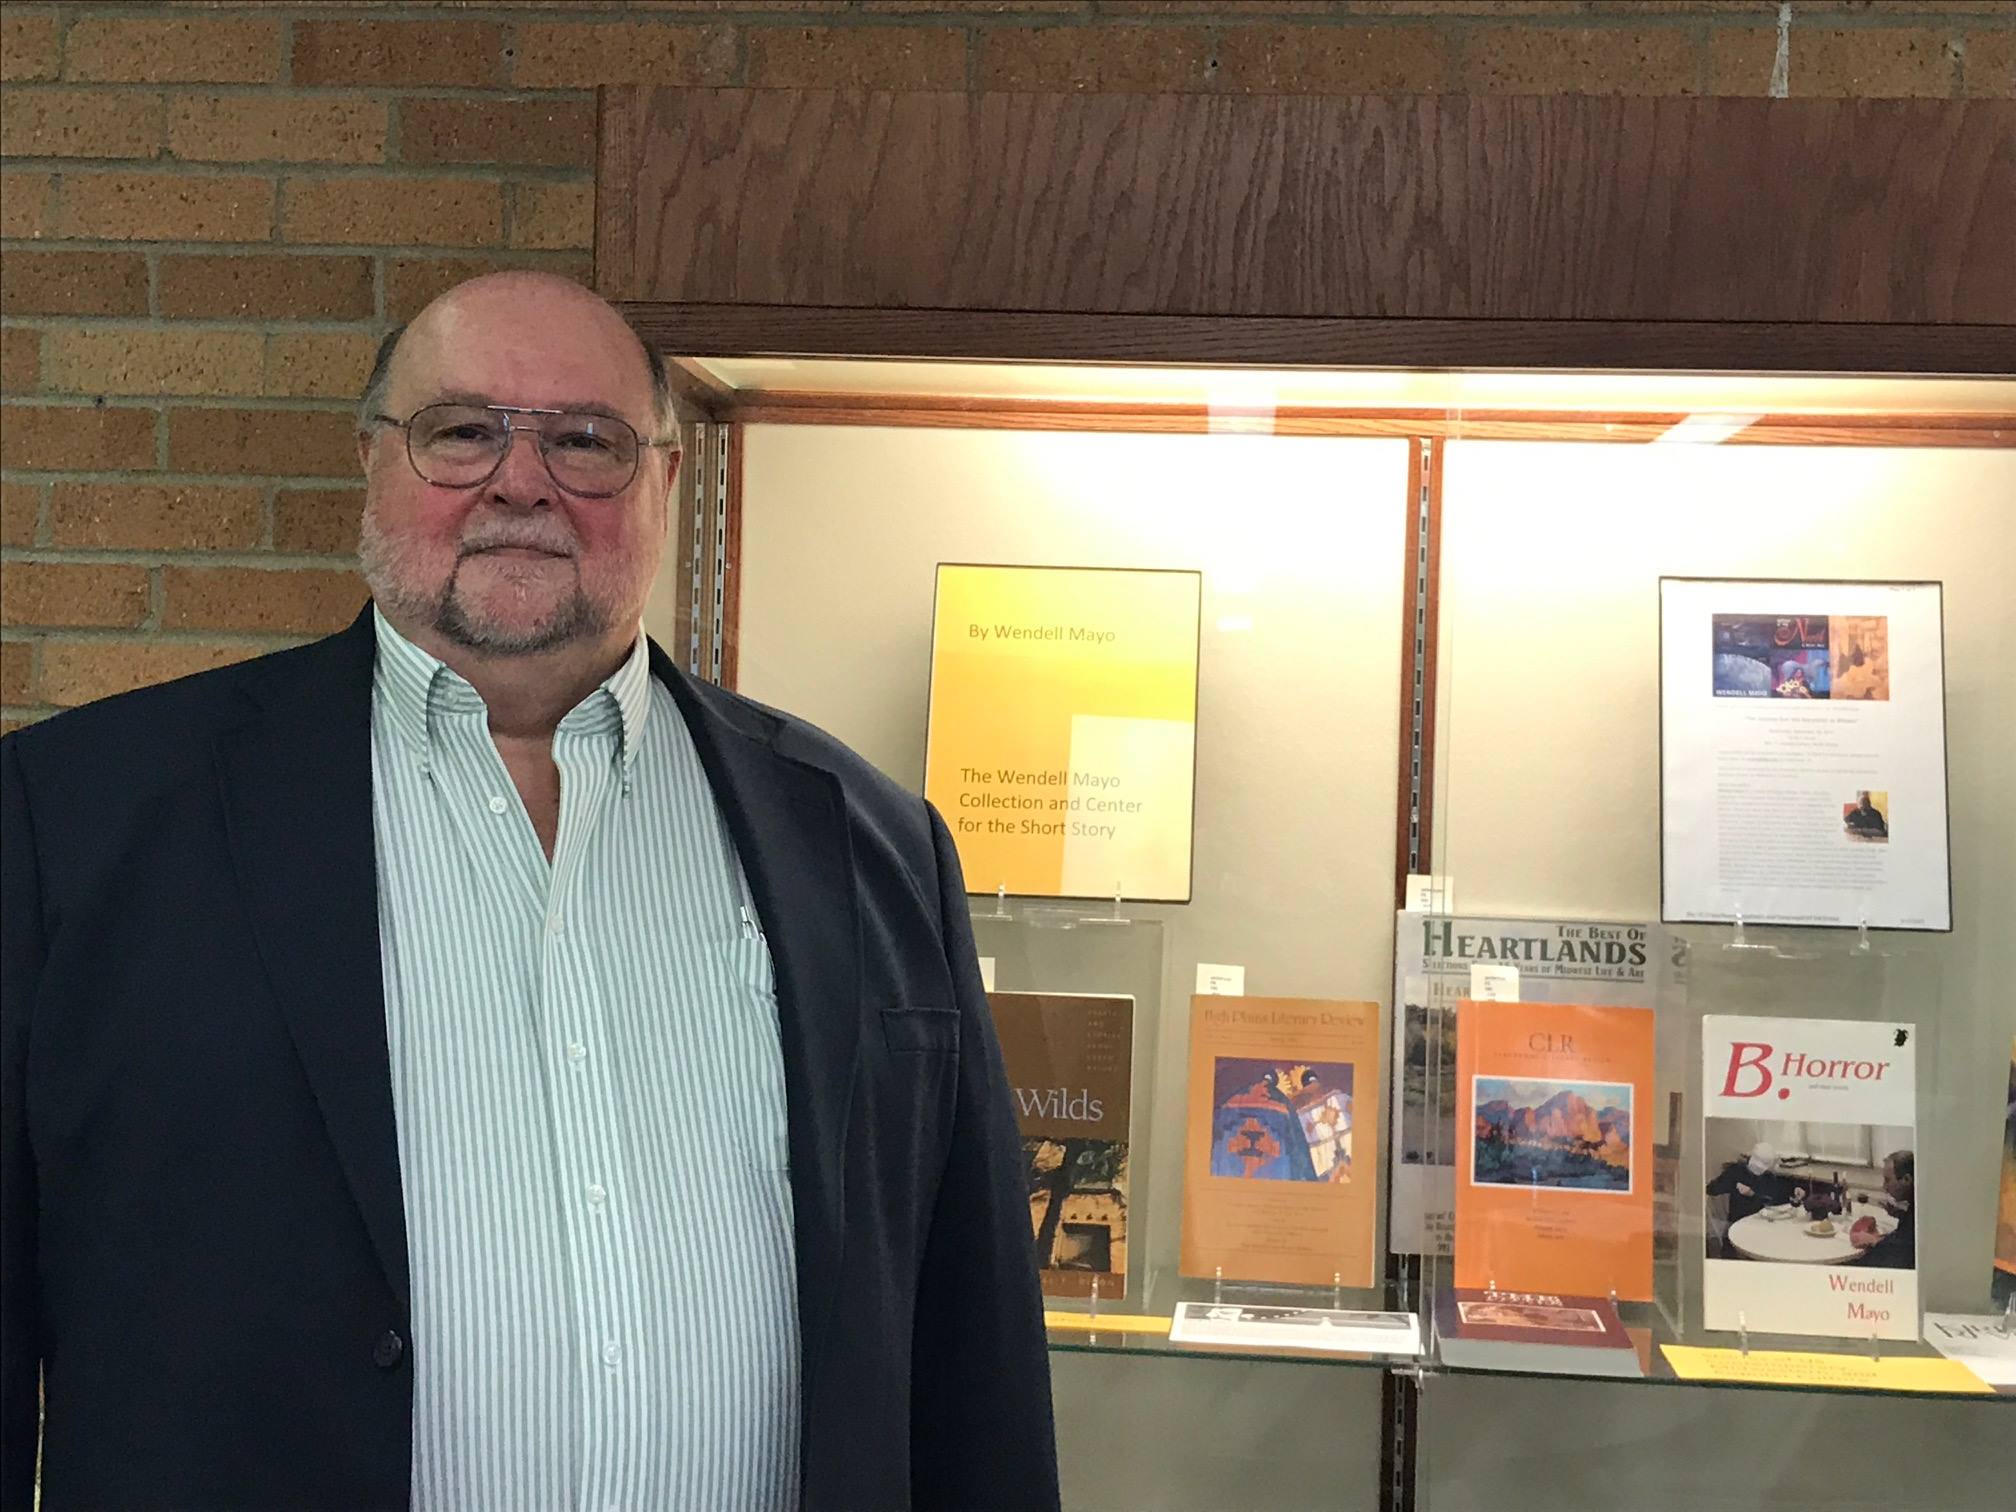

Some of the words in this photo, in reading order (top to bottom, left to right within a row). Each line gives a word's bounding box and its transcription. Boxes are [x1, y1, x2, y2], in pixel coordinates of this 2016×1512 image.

[969, 623, 989, 641] By
[994, 624, 1063, 641] Wendell
[1069, 626, 1116, 643] Mayo
[961, 768, 992, 784] The
[998, 769, 1067, 786] Wendell
[1073, 772, 1121, 789] Mayo
[960, 793, 1044, 811] Collection
[1049, 796, 1080, 811] and
[1085, 797, 1143, 813] Center
[958, 817, 982, 834] for
[987, 818, 1016, 834] the
[1021, 819, 1066, 836] Short
[1071, 821, 1116, 839] Story
[1422, 920, 1647, 966] HEARTLANDS
[1528, 1032, 1576, 1053] CLR
[1719, 1041, 1790, 1100] B.
[1781, 1053, 1890, 1081] Horror
[1013, 1087, 1104, 1122] Wilds
[1829, 1274, 1894, 1294] Wendell
[1847, 1301, 1890, 1321] Mayo
